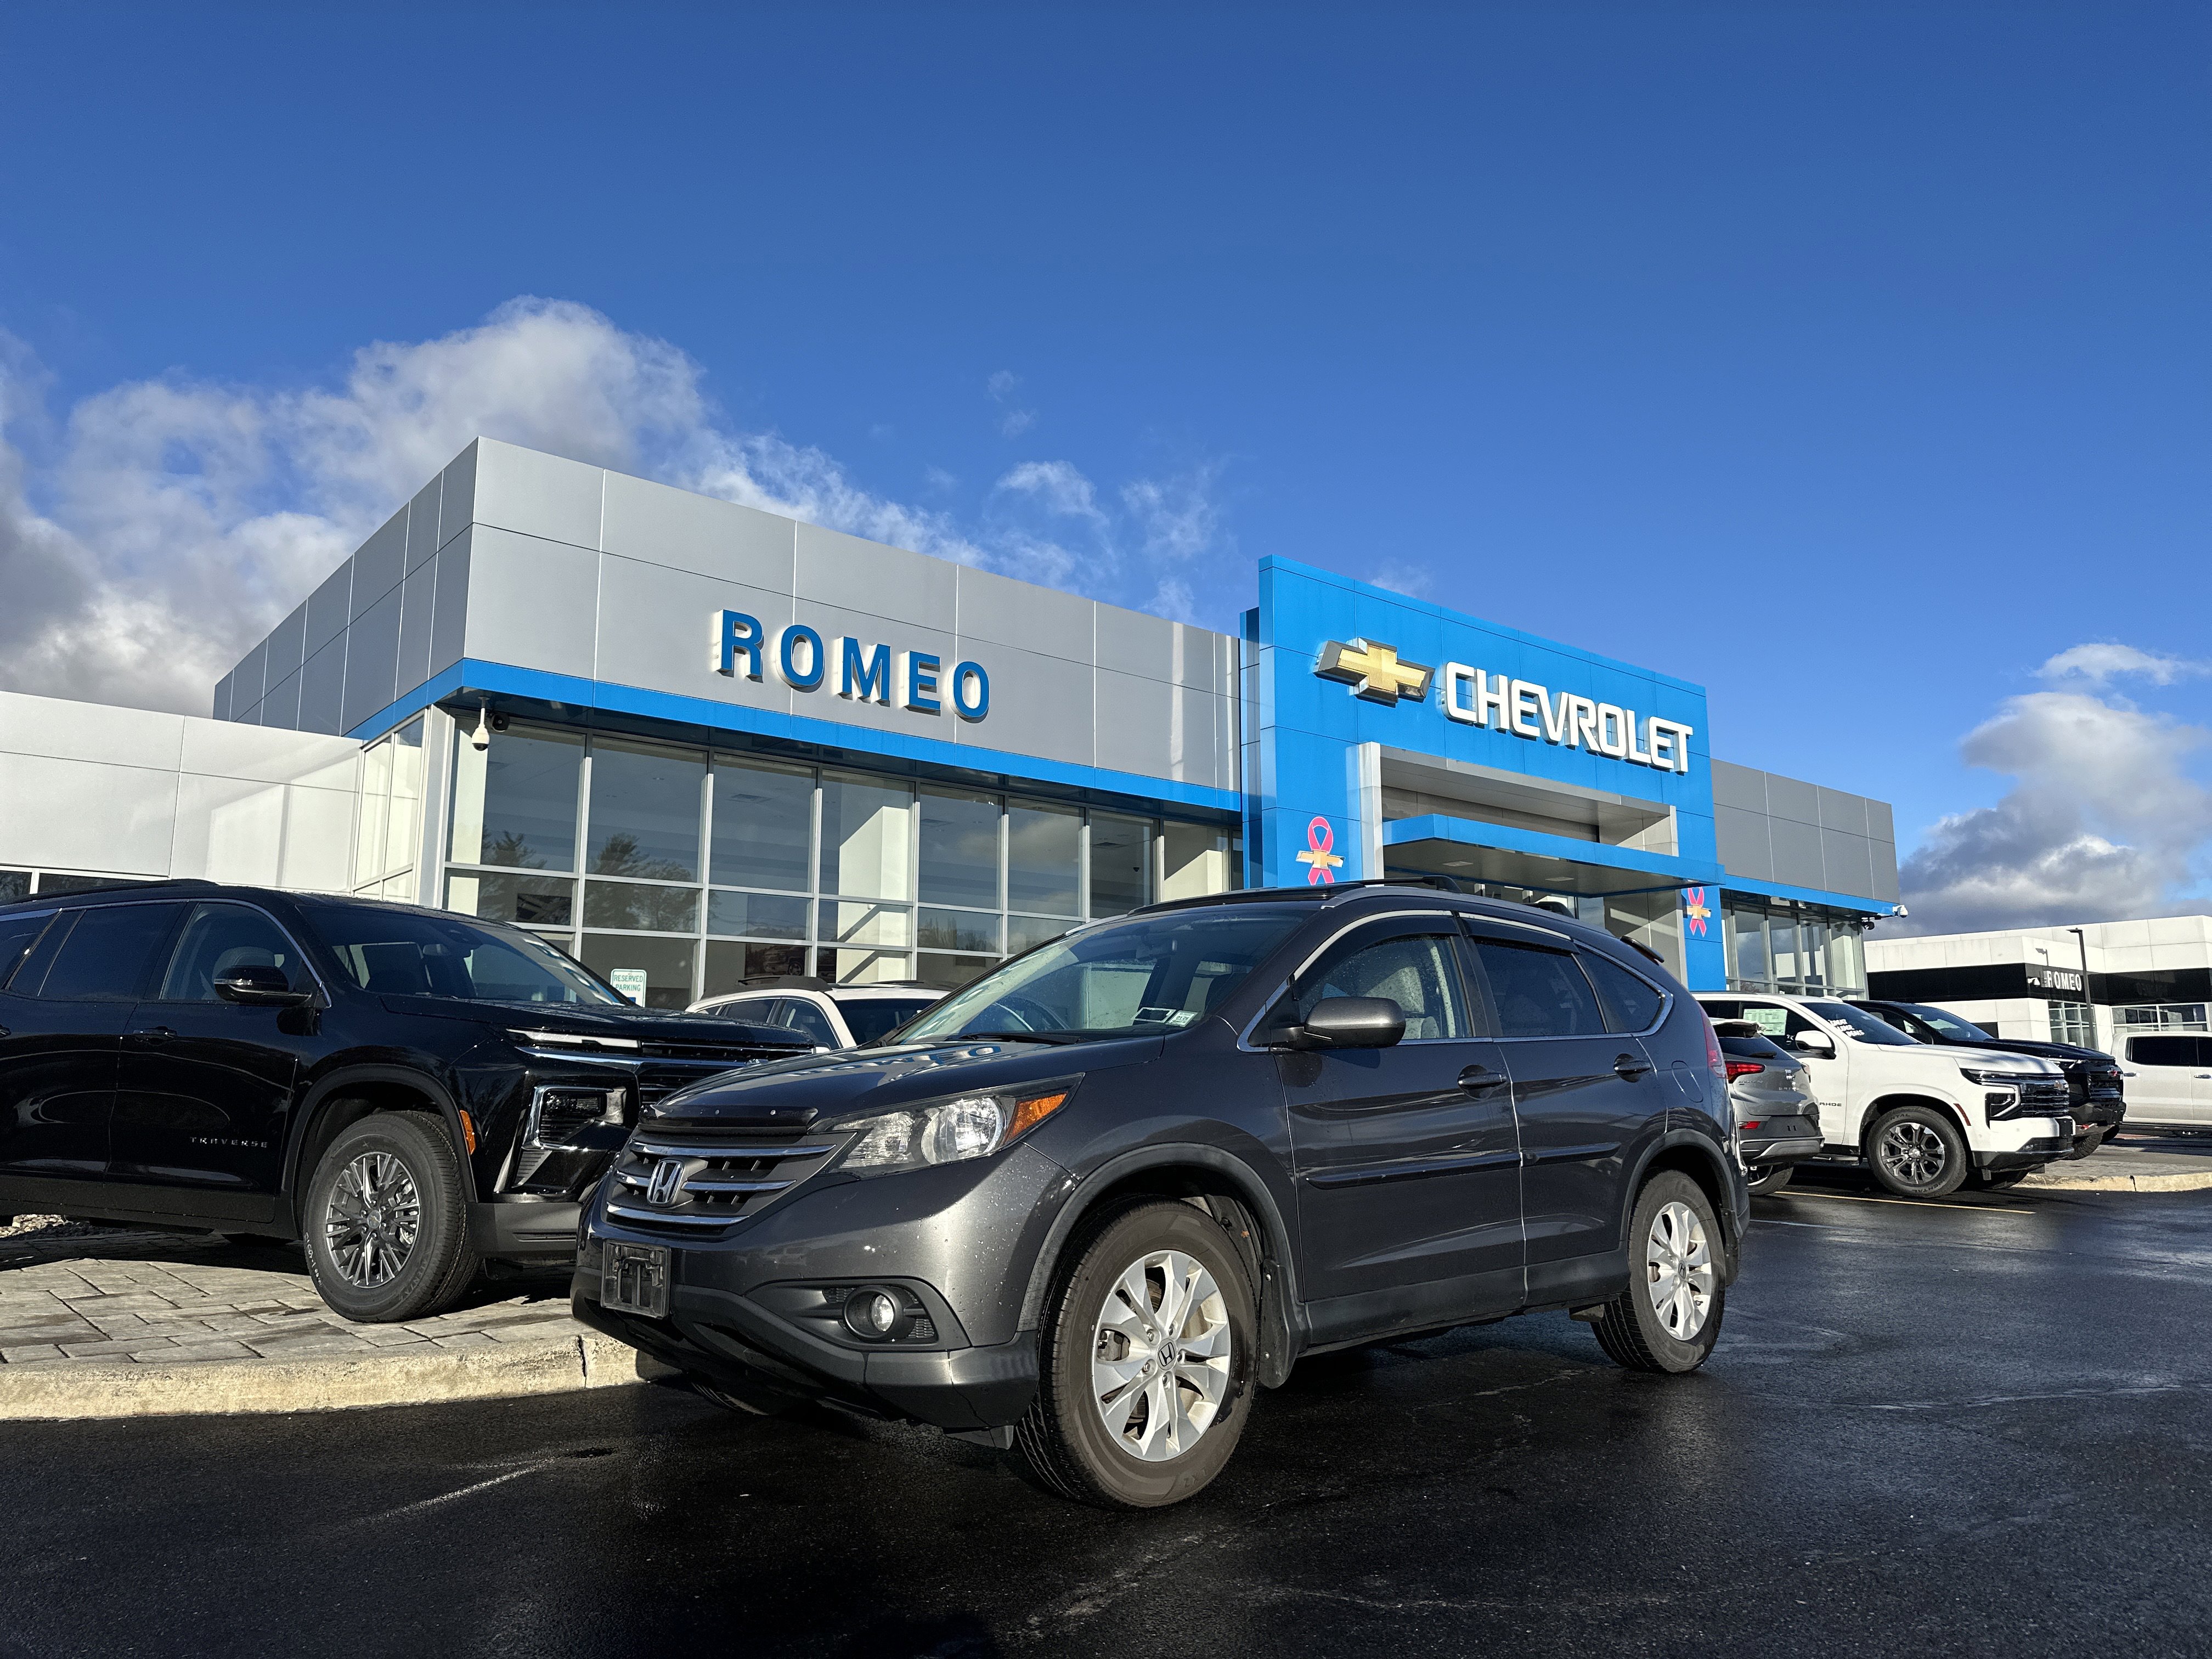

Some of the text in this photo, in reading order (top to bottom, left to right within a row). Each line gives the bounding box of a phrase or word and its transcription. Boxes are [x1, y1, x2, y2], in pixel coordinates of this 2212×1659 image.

[715, 609, 990, 720] ROMEO
[1444, 661, 1694, 774] CHEVROLET
[2046, 970, 2082, 991] ROMEO
